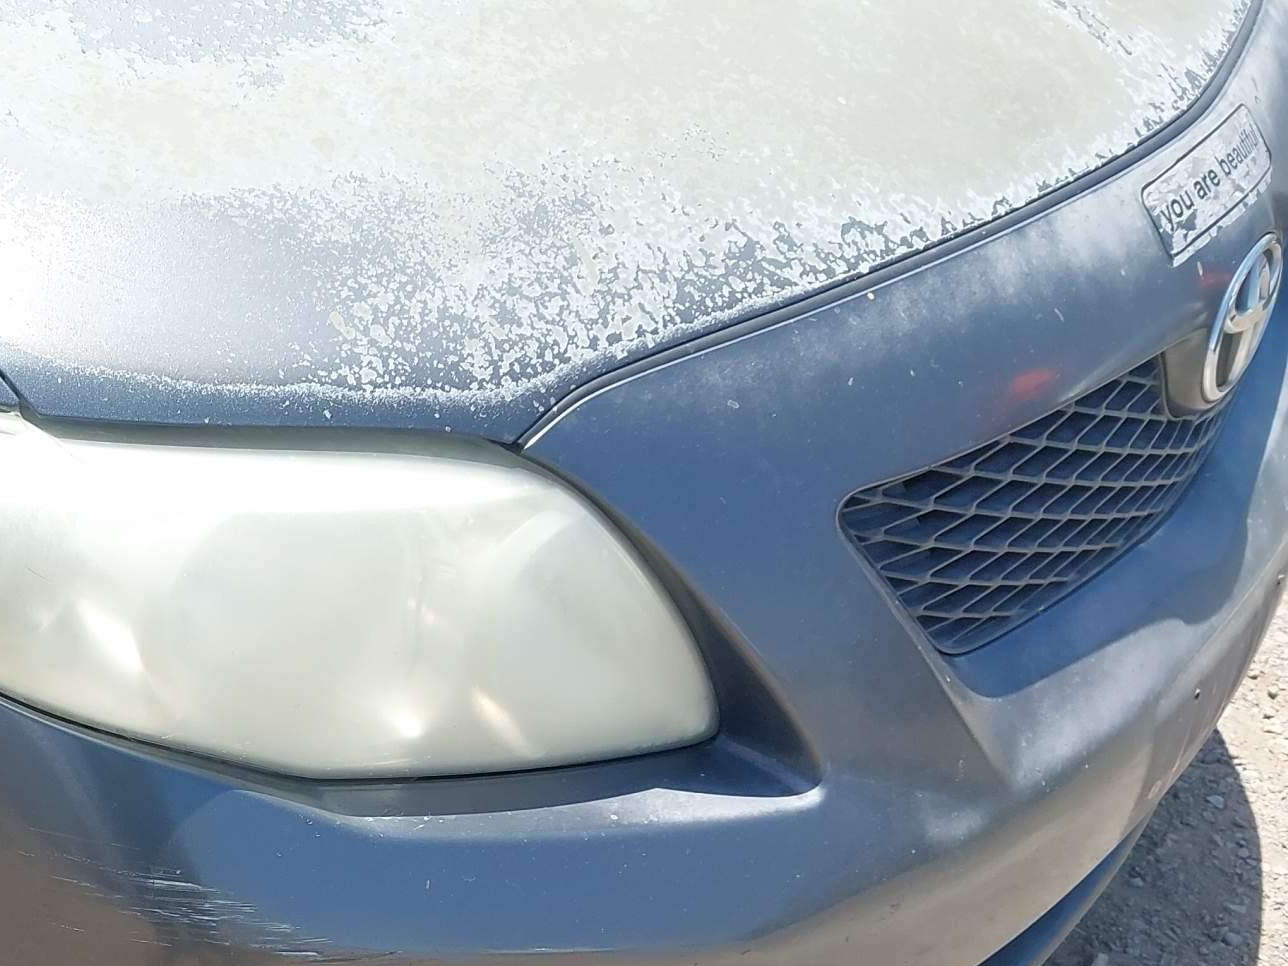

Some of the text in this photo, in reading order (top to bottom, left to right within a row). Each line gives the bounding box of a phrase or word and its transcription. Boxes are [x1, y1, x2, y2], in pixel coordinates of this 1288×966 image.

[1160, 125, 1259, 232] you are beautiful
